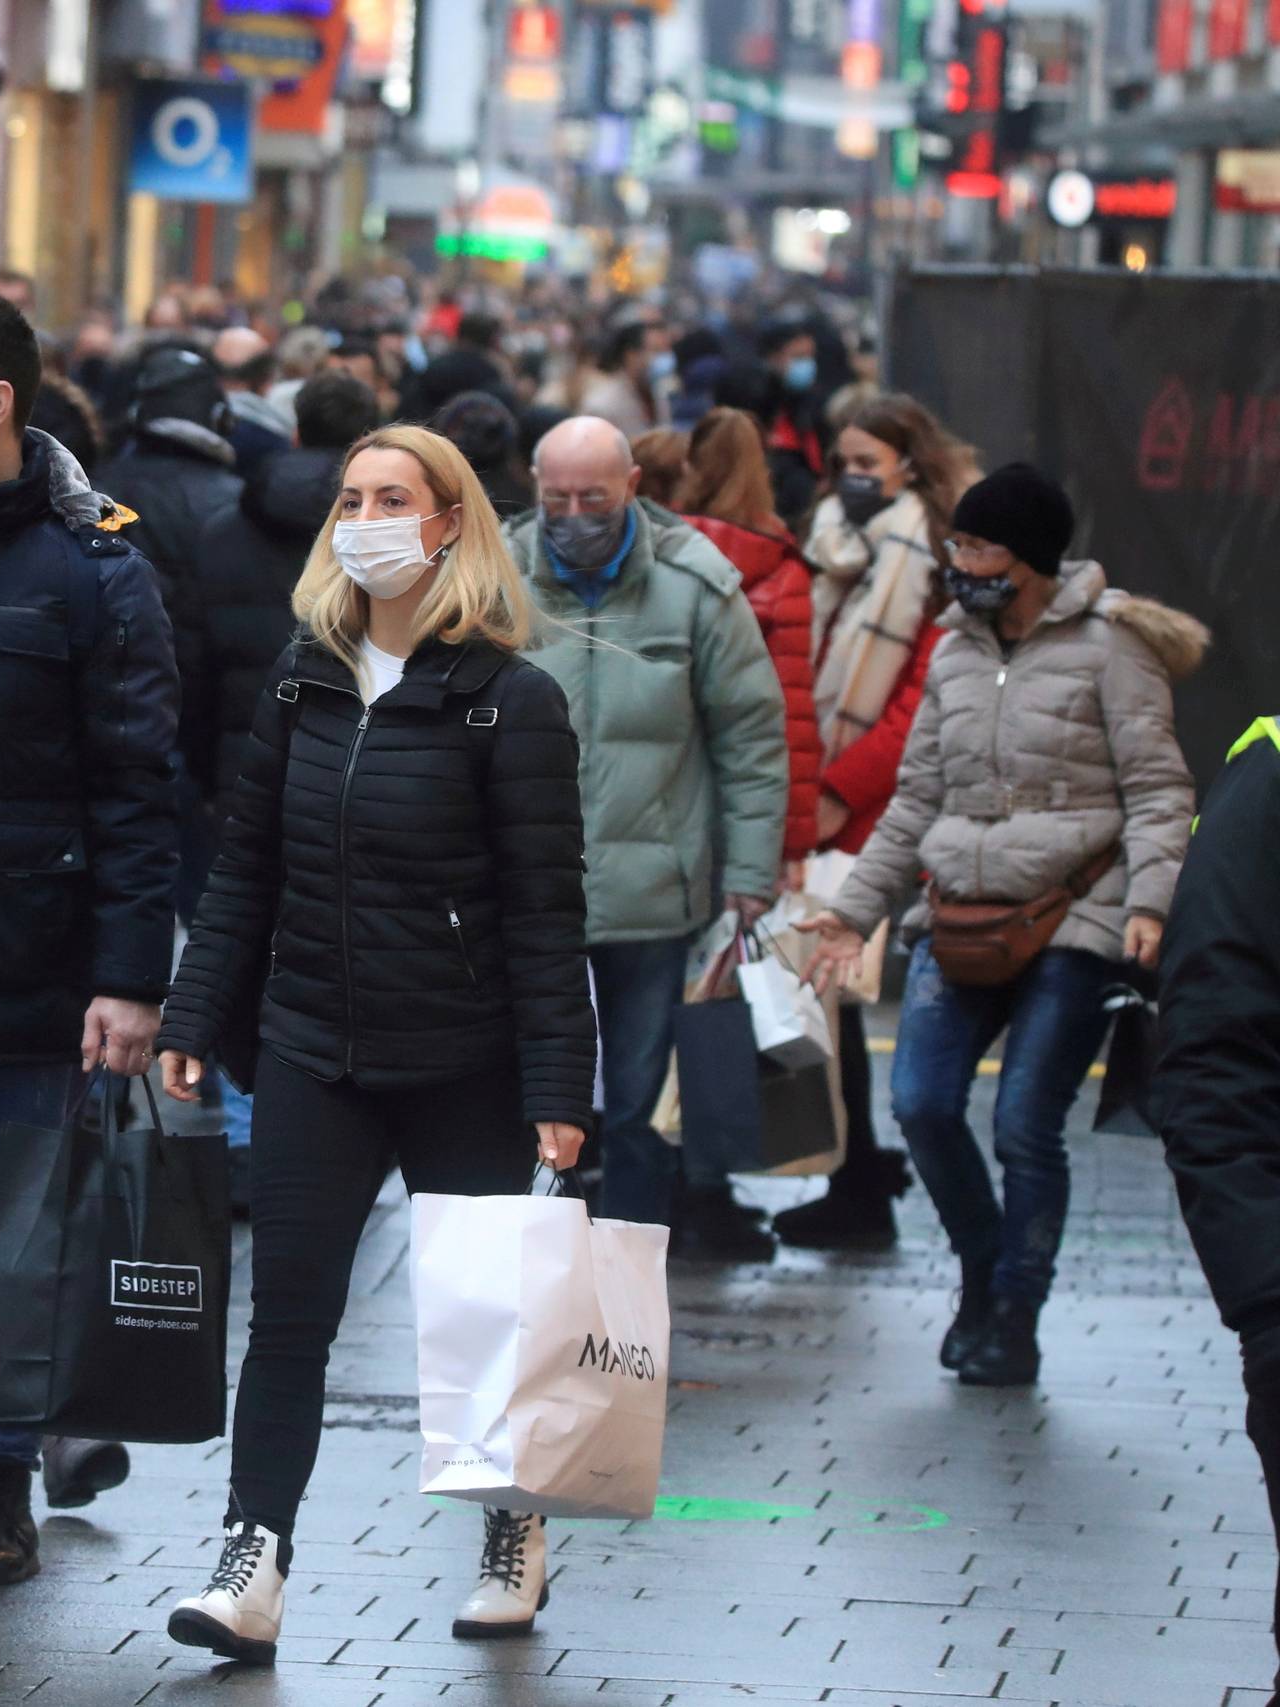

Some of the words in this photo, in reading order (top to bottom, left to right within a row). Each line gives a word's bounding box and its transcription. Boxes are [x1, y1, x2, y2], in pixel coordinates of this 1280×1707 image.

[120, 1275, 197, 1296] SIDESTEP
[114, 1314, 200, 1332] sidestep-shoes.com
[577, 1332, 656, 1382] MANGO
